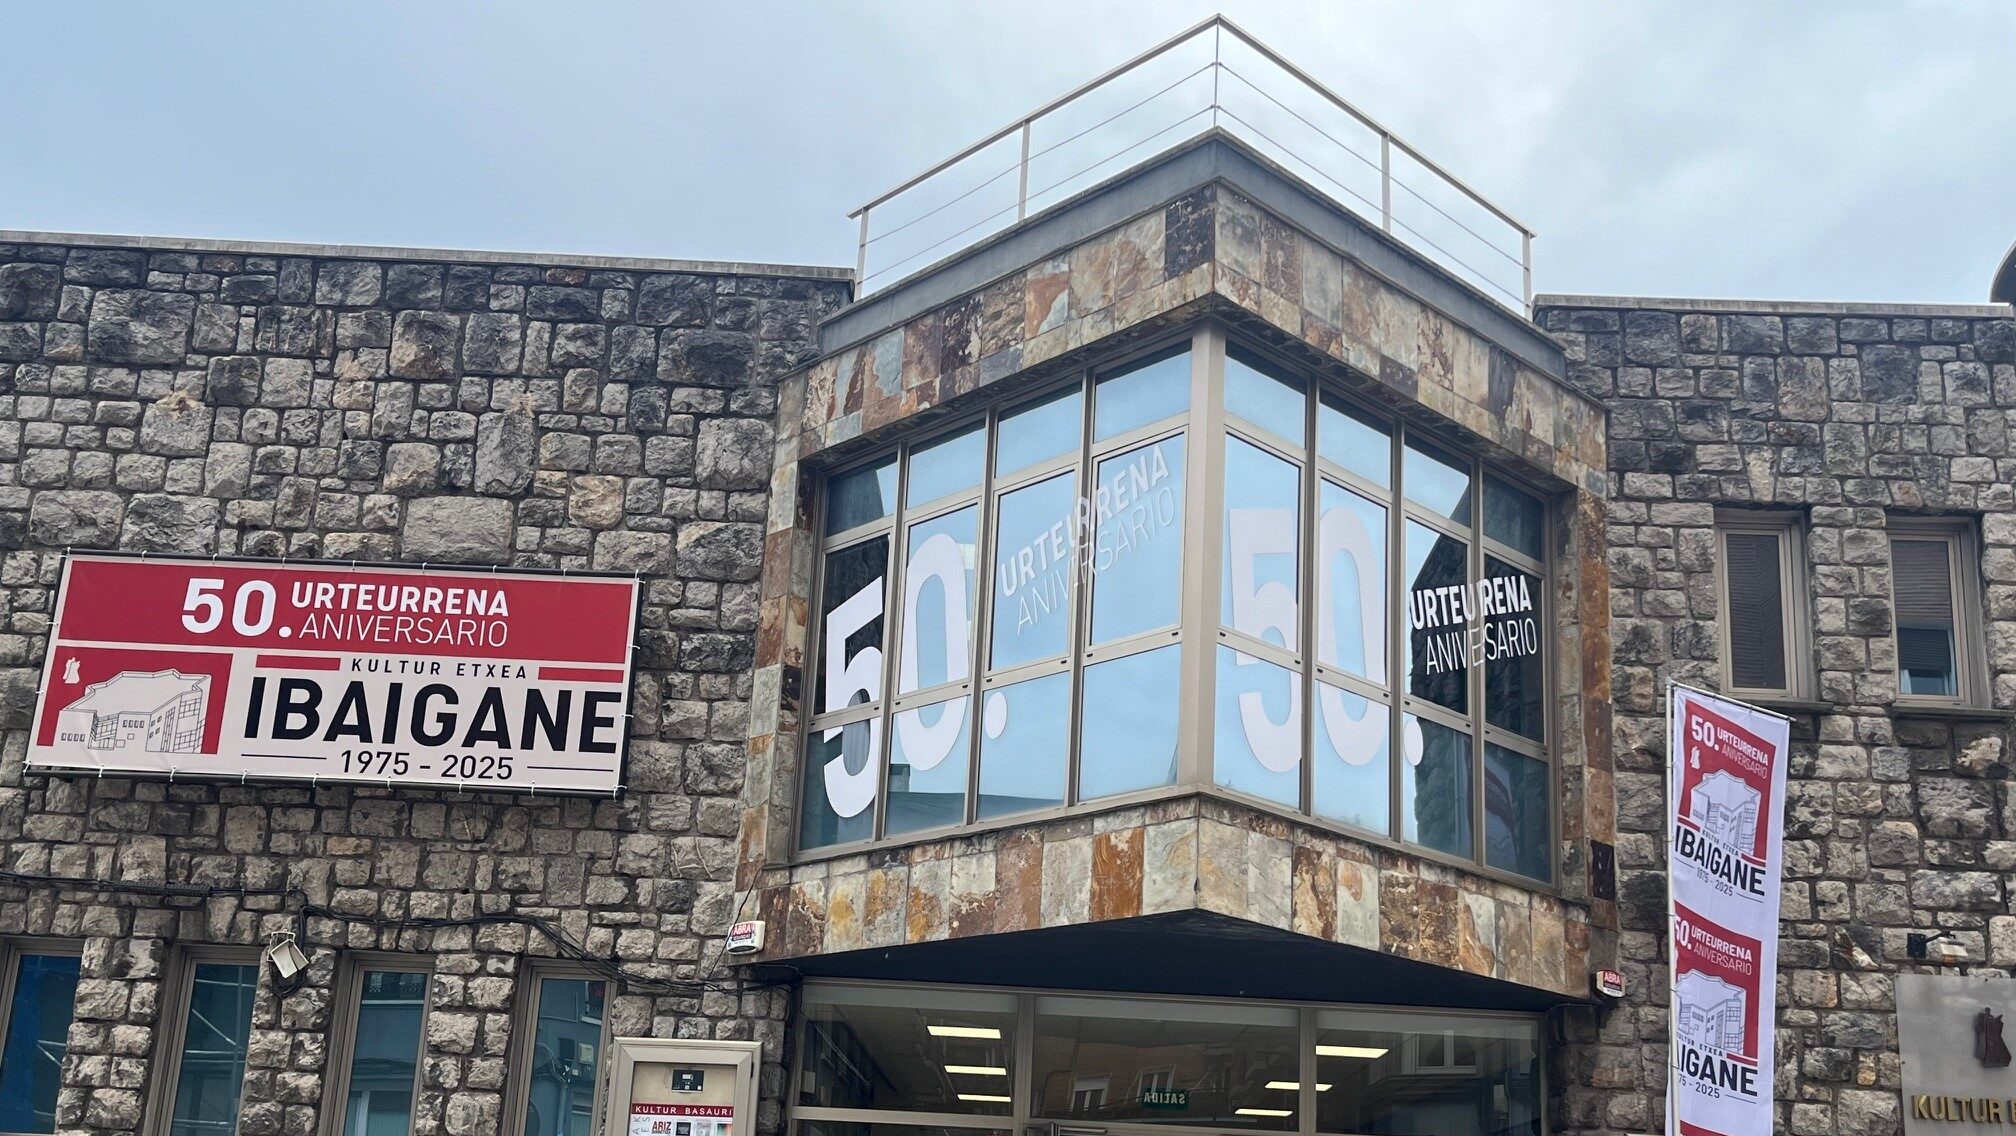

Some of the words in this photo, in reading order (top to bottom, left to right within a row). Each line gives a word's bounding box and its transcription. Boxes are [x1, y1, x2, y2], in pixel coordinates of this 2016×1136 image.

[181, 578, 293, 639] 50.
[291, 582, 510, 618] URTEURRENA
[1410, 575, 1533, 630] URTEURENA
[299, 613, 510, 648] ANIVERSARIO
[1229, 506, 1424, 773] 50.
[1426, 617, 1538, 675] ANIVESARIO
[351, 657, 442, 676] KULTUR
[456, 662, 529, 680] ETXEA
[823, 533, 1009, 819] 50.
[244, 676, 623, 755] IBAIGANE
[1691, 714, 1720, 751] 50.
[1716, 726, 1769, 766] URTEURRENA
[1721, 743, 1768, 779] ANIVERSARIO
[341, 750, 410, 777] 1975
[441, 754, 514, 781] 2025
[1674, 825, 1767, 896] IBAIGANE
[1714, 880, 1734, 896] 2025
[1691, 925, 1753, 962] URTEURRENA
[1693, 942, 1752, 976] ANIVERSARIO
[1678, 1043, 1758, 1097] IGANE
[1695, 1081, 1720, 1099] 2025
[1911, 1094, 2003, 1123] KULTUR
[635, 1105, 677, 1114] KULTUR
[684, 1107, 733, 1116] BASAURI
